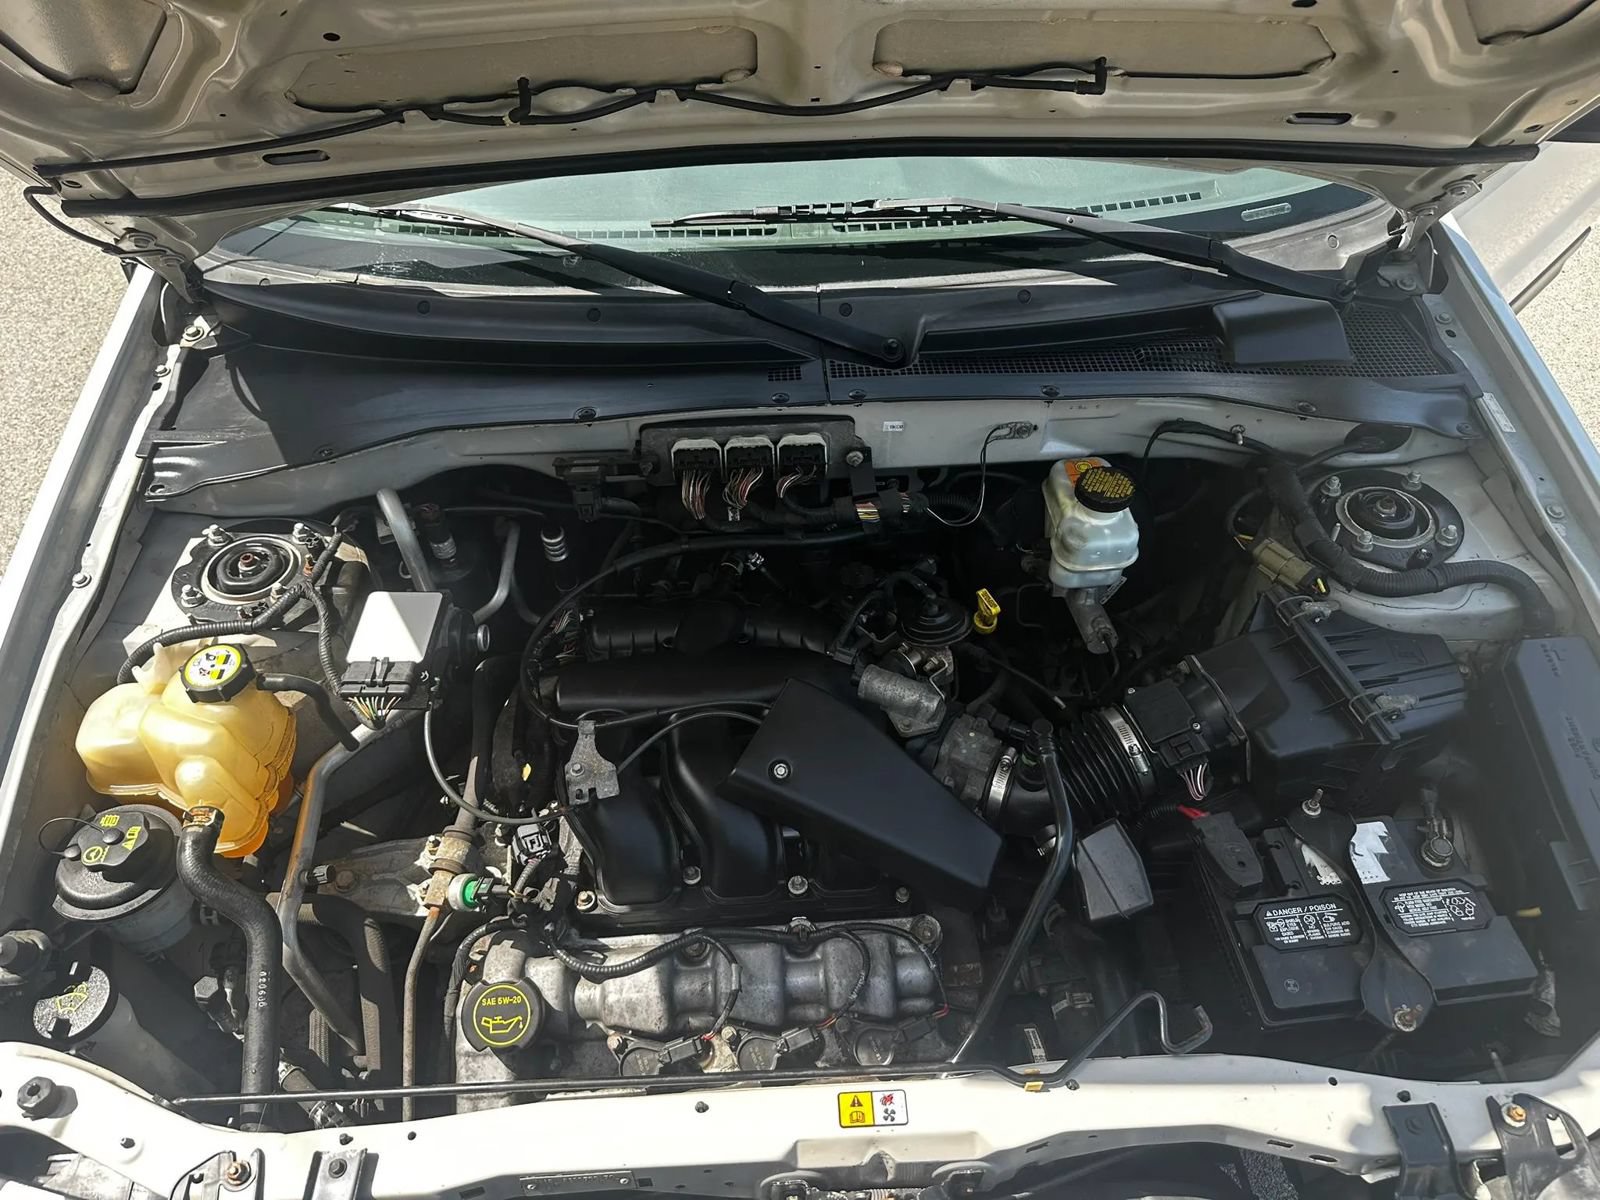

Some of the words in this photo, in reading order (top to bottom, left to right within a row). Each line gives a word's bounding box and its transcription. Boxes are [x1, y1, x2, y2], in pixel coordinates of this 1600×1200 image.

[1272, 907, 1303, 916] DANGER
[1309, 902, 1337, 912] POISON
[481, 998, 497, 1006] SAE
[497, 996, 522, 1005] 5W-20
